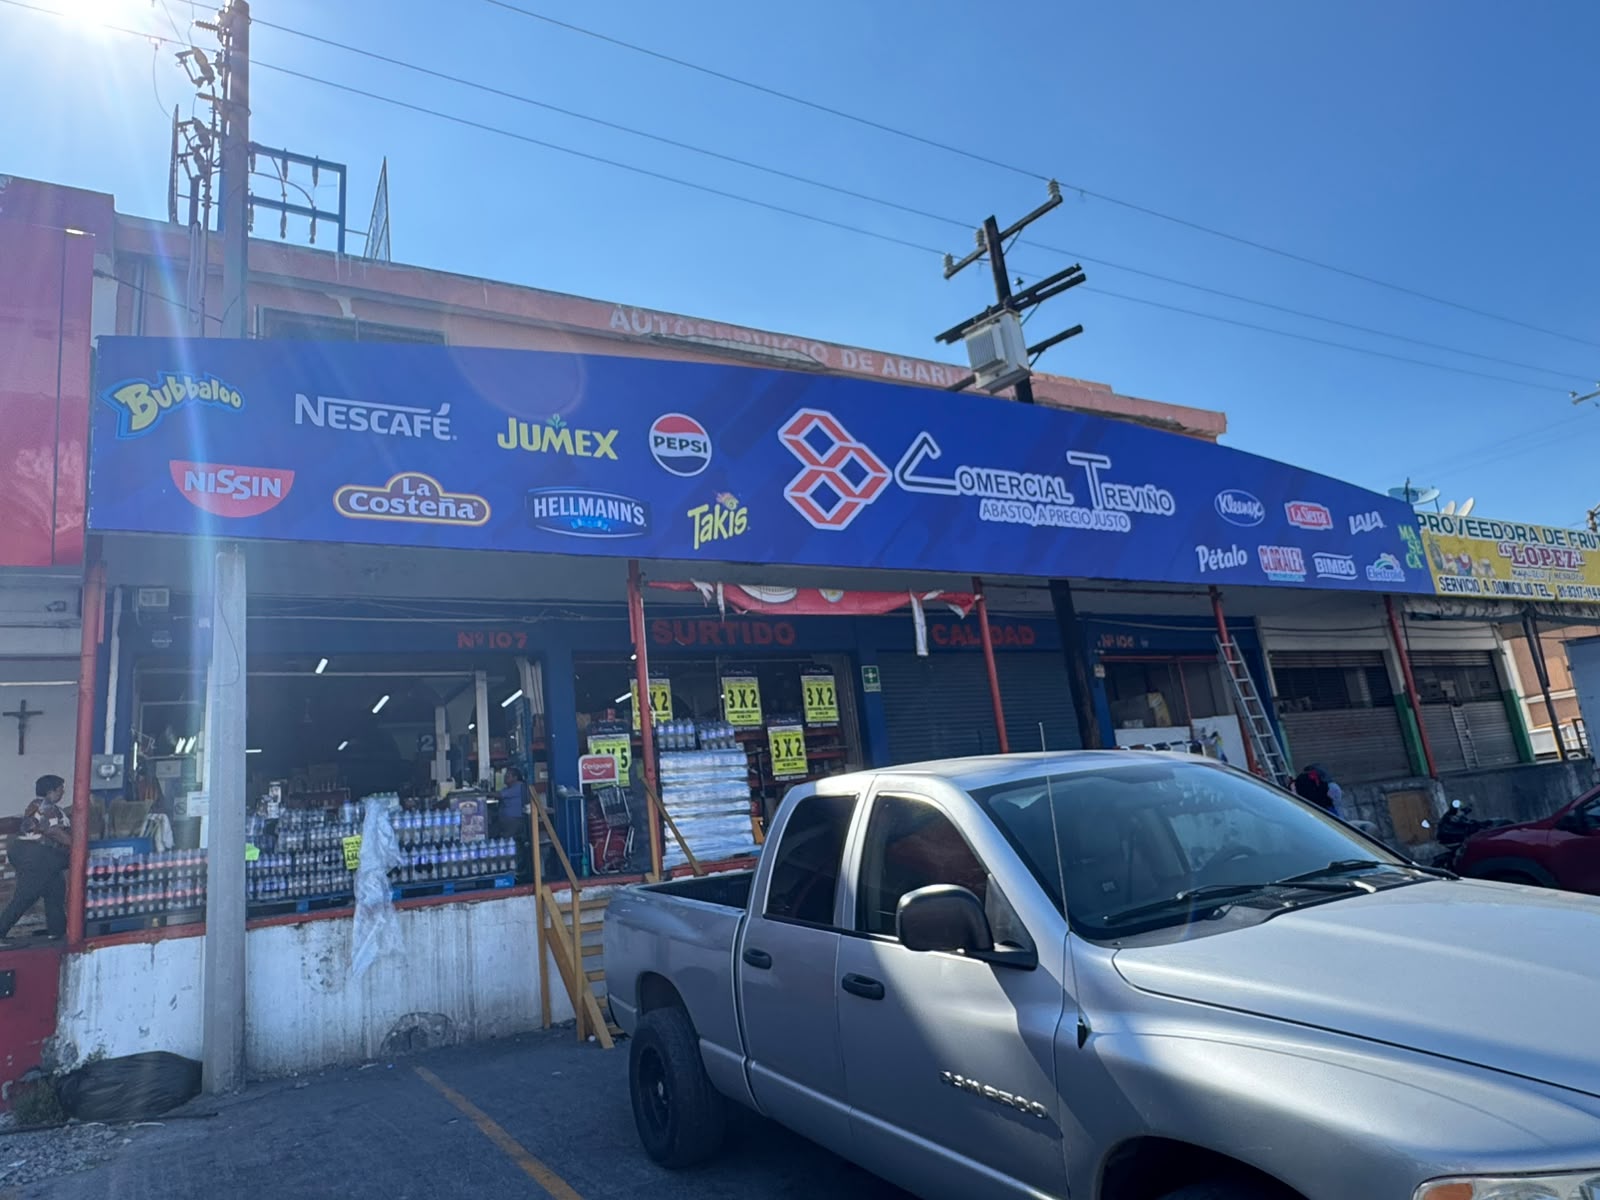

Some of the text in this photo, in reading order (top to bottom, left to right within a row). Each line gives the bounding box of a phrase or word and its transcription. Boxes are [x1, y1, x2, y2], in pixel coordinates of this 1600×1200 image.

[842, 350, 876, 372] DE
[113, 376, 243, 431] Bubbaloo
[294, 393, 453, 441] NESCAFÉ
[497, 416, 619, 460] JUMEX
[653, 435, 708, 454] PEPSI
[184, 468, 281, 500] NISSIN
[895, 431, 1176, 517] COMERCIAL TREVIÑO
[402, 477, 431, 498] La
[348, 491, 477, 520] Costeña
[533, 496, 645, 526] HELLMANN'S
[1037, 507, 1048, 522] A
[1050, 508, 1092, 526] PRECIO
[1093, 511, 1130, 530] JUSTO
[1217, 493, 1265, 520] Kleenex
[687, 499, 749, 550] Takis
[1415, 513, 1542, 544] PROVEEDORA
[1542, 527, 1567, 547] DE
[1195, 544, 1248, 573] Pétalo
[1314, 557, 1357, 575] BIMBO
[1438, 575, 1481, 593] SERVICIO
[1491, 580, 1534, 596] DOMICILIO
[487, 630, 529, 650] 107
[651, 619, 797, 646] SURTIDO
[930, 622, 1036, 647] CALDAD
[660, 691, 669, 711] 2
[727, 688, 758, 709] 3 X 2
[806, 687, 814, 706] 3
[826, 687, 835, 706] 2
[773, 739, 782, 759] 3
[794, 737, 803, 757] 2
